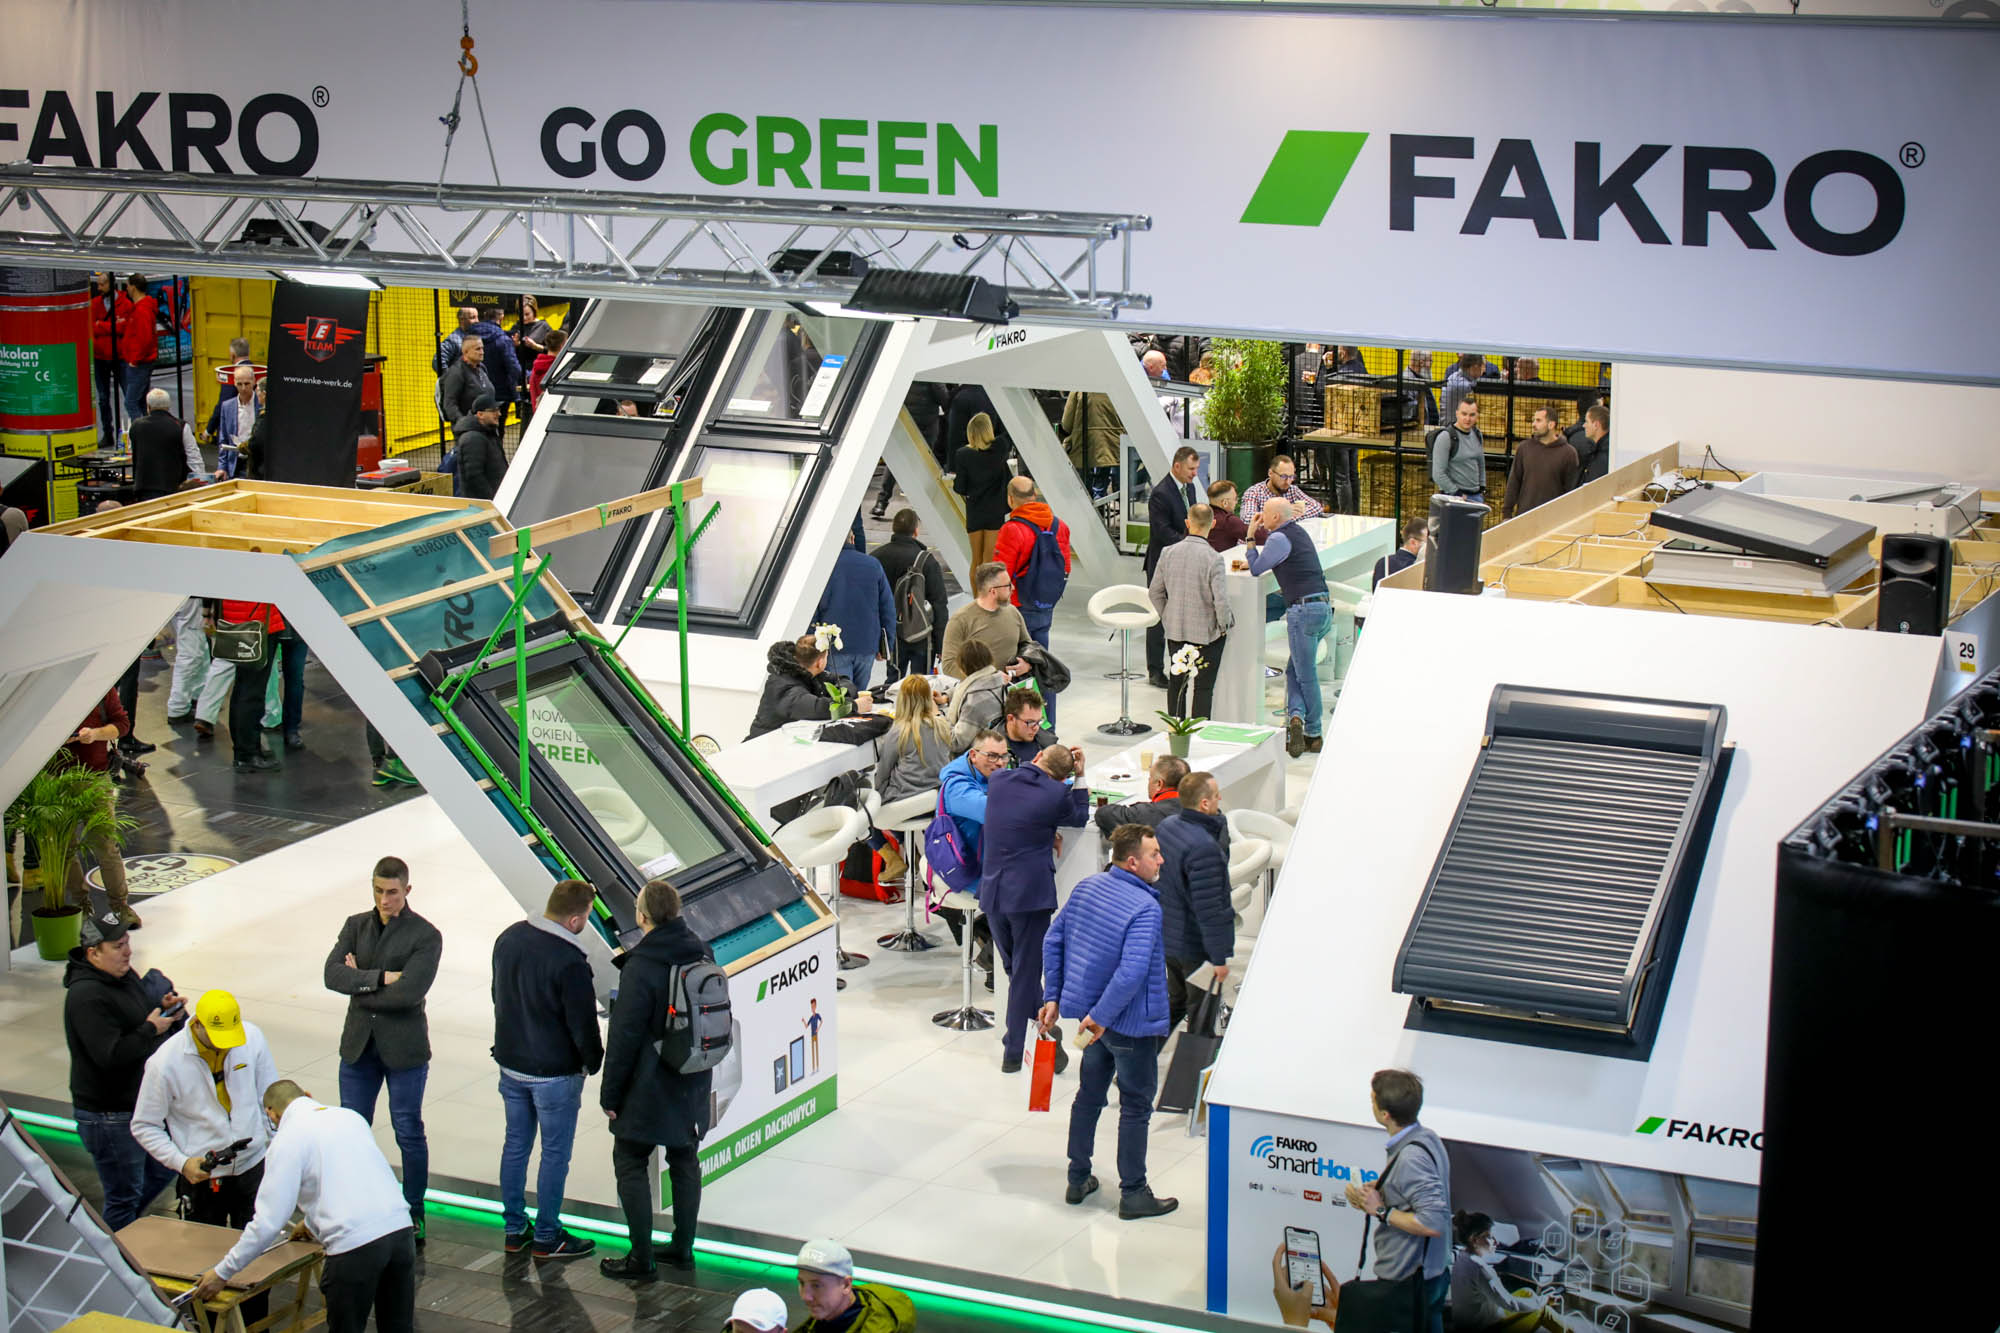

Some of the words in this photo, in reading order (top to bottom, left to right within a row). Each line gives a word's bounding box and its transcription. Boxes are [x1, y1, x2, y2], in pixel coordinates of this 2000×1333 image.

[540, 106, 666, 182] GO
[689, 112, 998, 198] GREEN
[1389, 133, 1906, 257] FAKRO
[471, 295, 499, 304] WELCOME
[307, 340, 333, 352] TEAM
[995, 329, 1027, 348] FAKRO
[283, 376, 353, 388] www.enke-werk.de
[612, 504, 632, 517] FAKRO
[1959, 641, 1975, 659] 29
[532, 726, 572, 742] OKIEN
[769, 954, 820, 995] FAKRO
[700, 1146, 732, 1178] MIANA
[735, 1128, 762, 1158] OKIEN
[765, 1096, 817, 1142] DACHOWYCH
[1276, 1136, 1318, 1153] FAKRO
